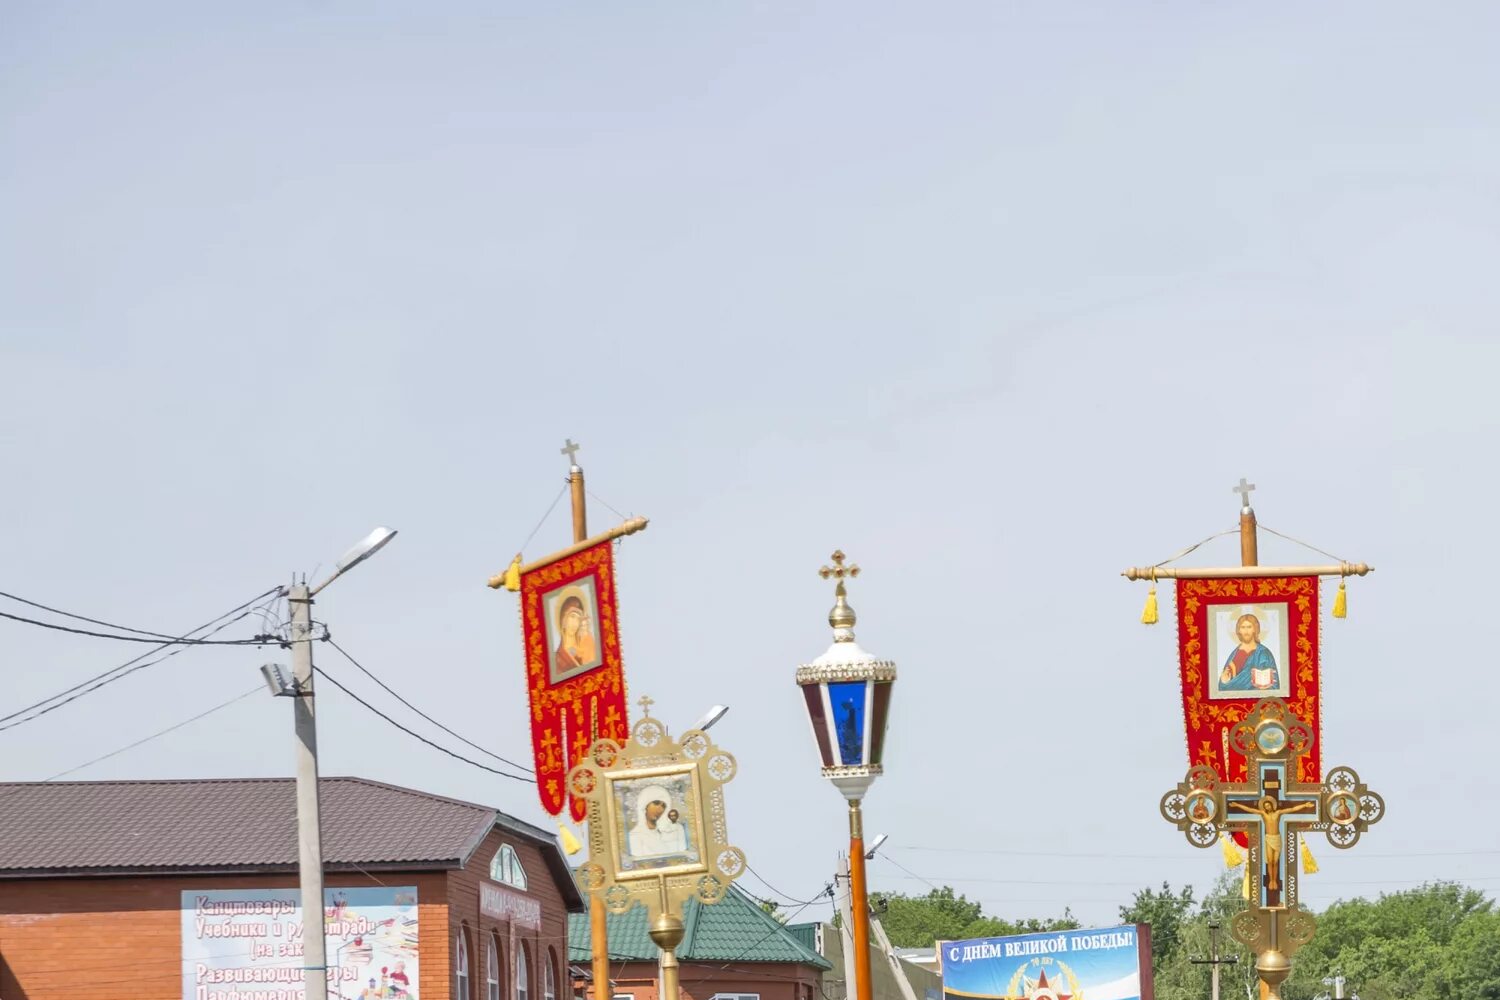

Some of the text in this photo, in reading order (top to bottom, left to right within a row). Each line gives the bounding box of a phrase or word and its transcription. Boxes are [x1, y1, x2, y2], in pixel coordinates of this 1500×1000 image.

[195, 895, 295, 920] Канцтовары
[196, 917, 266, 939] Учебники
[273, 922, 281, 937] и
[251, 937, 273, 960] (на
[950, 932, 1133, 963] С ДНЁМ ВЕЛИКОЙ ПОБЕДЫ!
